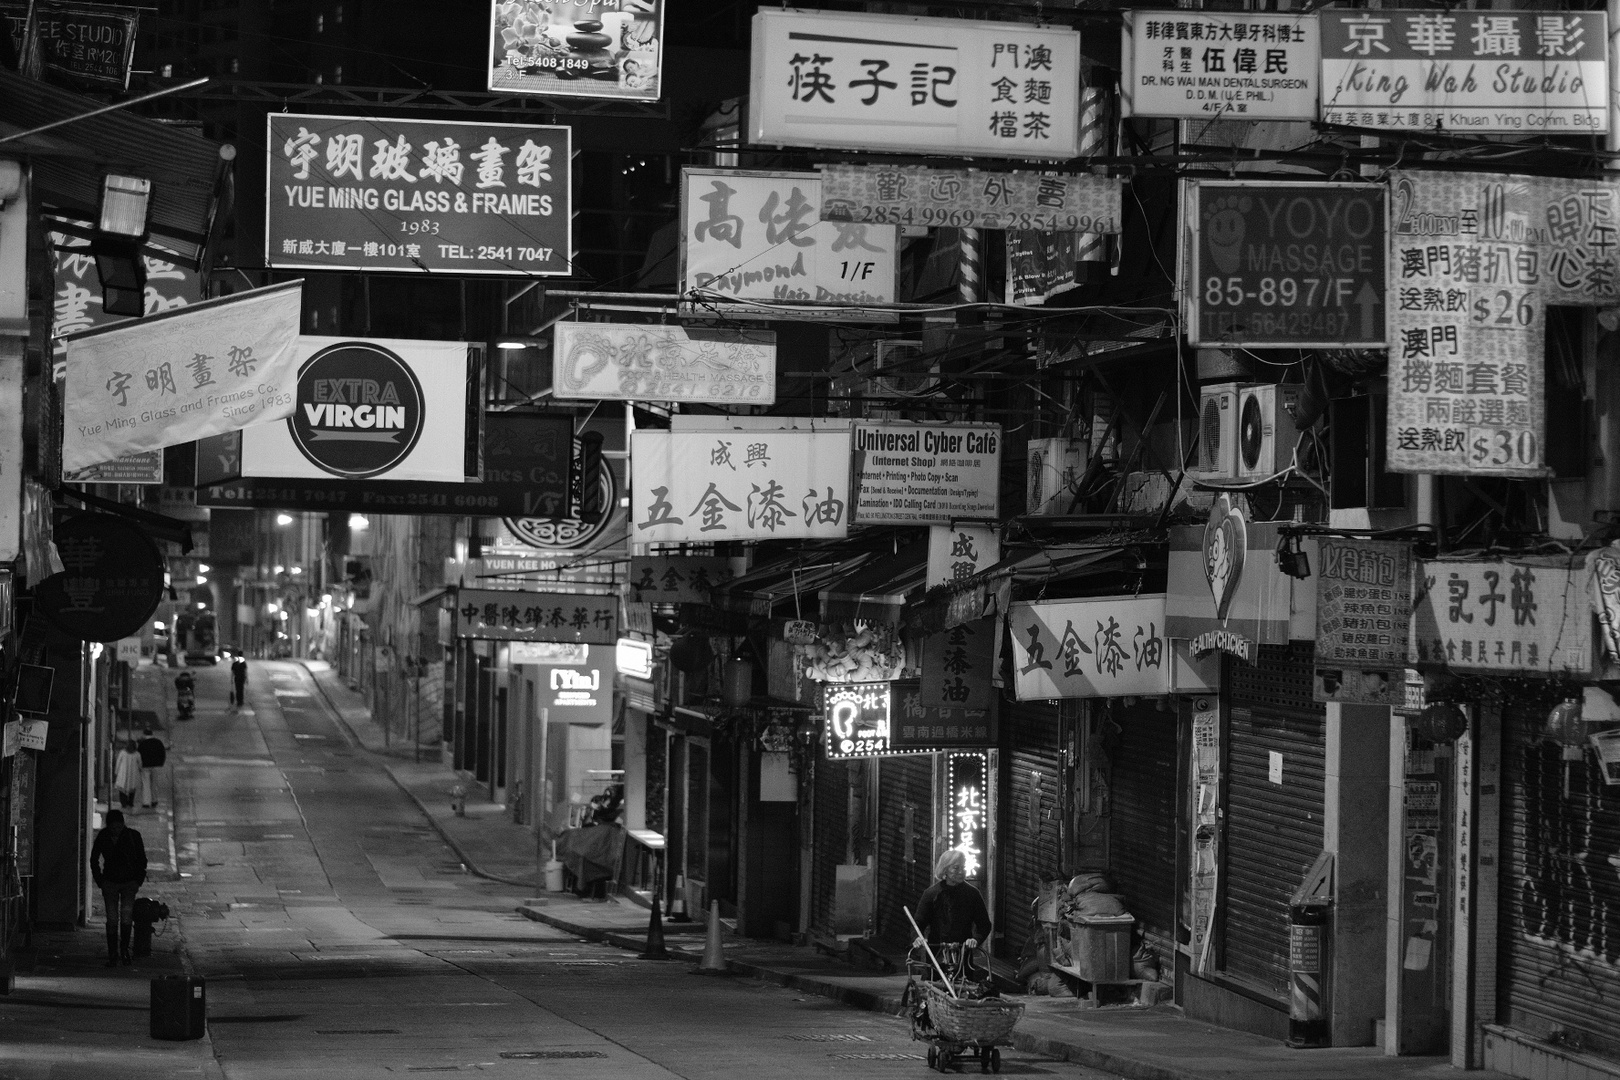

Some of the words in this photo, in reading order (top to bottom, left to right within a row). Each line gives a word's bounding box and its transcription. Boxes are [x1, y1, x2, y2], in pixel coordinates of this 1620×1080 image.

[1146, 21, 1305, 43] 菲律賓東方大學牙科博士
[1341, 13, 1585, 56] 京華攝影
[560, 58, 589, 69] 1849
[1201, 47, 1288, 74] 伍偉民
[788, 53, 957, 107] 筷子記
[1142, 76, 1158, 86] DR.
[1160, 77, 1175, 86] NG
[1177, 77, 1196, 87] WAI
[1199, 78, 1220, 87] MAN
[1346, 63, 1409, 103] King
[1493, 63, 1583, 93] Studio
[1450, 114, 1489, 126] Khuan
[1495, 114, 1521, 128] Ying
[1573, 113, 1600, 128] Bldg
[284, 127, 553, 189] 宇明玻璃畫架
[284, 185, 324, 208] YUE
[329, 187, 379, 210] MING
[383, 189, 450, 213] GLASS
[454, 192, 468, 213] &
[473, 193, 553, 217] FRAMES
[876, 172, 1068, 209] 歡迎外賣
[400, 219, 440, 236] 1983
[861, 206, 914, 227] 2854
[922, 209, 975, 229] 9969
[1006, 211, 1058, 232] 2854
[1066, 214, 1116, 235] 9961
[1260, 197, 1374, 239] YOYO
[438, 244, 474, 260] TEL:
[478, 246, 512, 261] 2541
[518, 247, 553, 262] 7047
[1249, 244, 1372, 273] MASSAGE
[695, 252, 807, 295] Raymond
[840, 261, 877, 282] 1/F
[1399, 287, 1467, 312] 送熱飲
[1474, 290, 1534, 327] $26
[1400, 325, 1458, 359] 澳門
[106, 346, 257, 407] 宇明畫架
[665, 373, 705, 382] HEALTH
[711, 374, 764, 383] MASSAGE
[313, 378, 401, 404] EXTRA
[78, 424, 102, 438] Yue
[106, 416, 137, 432] Ming
[141, 407, 176, 424] Glass
[180, 399, 202, 415] and
[207, 388, 254, 408] Frames
[257, 384, 278, 395] Co.
[223, 403, 255, 419] Since
[261, 392, 292, 409] 1983
[304, 403, 406, 430] VIRGIN
[857, 429, 919, 451] Universal
[924, 430, 962, 455] Cyber
[967, 431, 996, 454] Café
[1398, 427, 1465, 452] 送熱飲
[1473, 430, 1536, 465] $30
[710, 440, 771, 471] 成興
[872, 455, 909, 467] (Internet
[911, 456, 936, 468] Shop)
[911, 472, 926, 482] Photo
[928, 472, 941, 484] Copy
[945, 473, 958, 482] Scan
[638, 480, 844, 532] 五金漆油
[486, 559, 514, 570] YUEN
[517, 559, 538, 570] KEE
[541, 560, 556, 570] HO
[1020, 616, 1162, 678] 五金漆油
